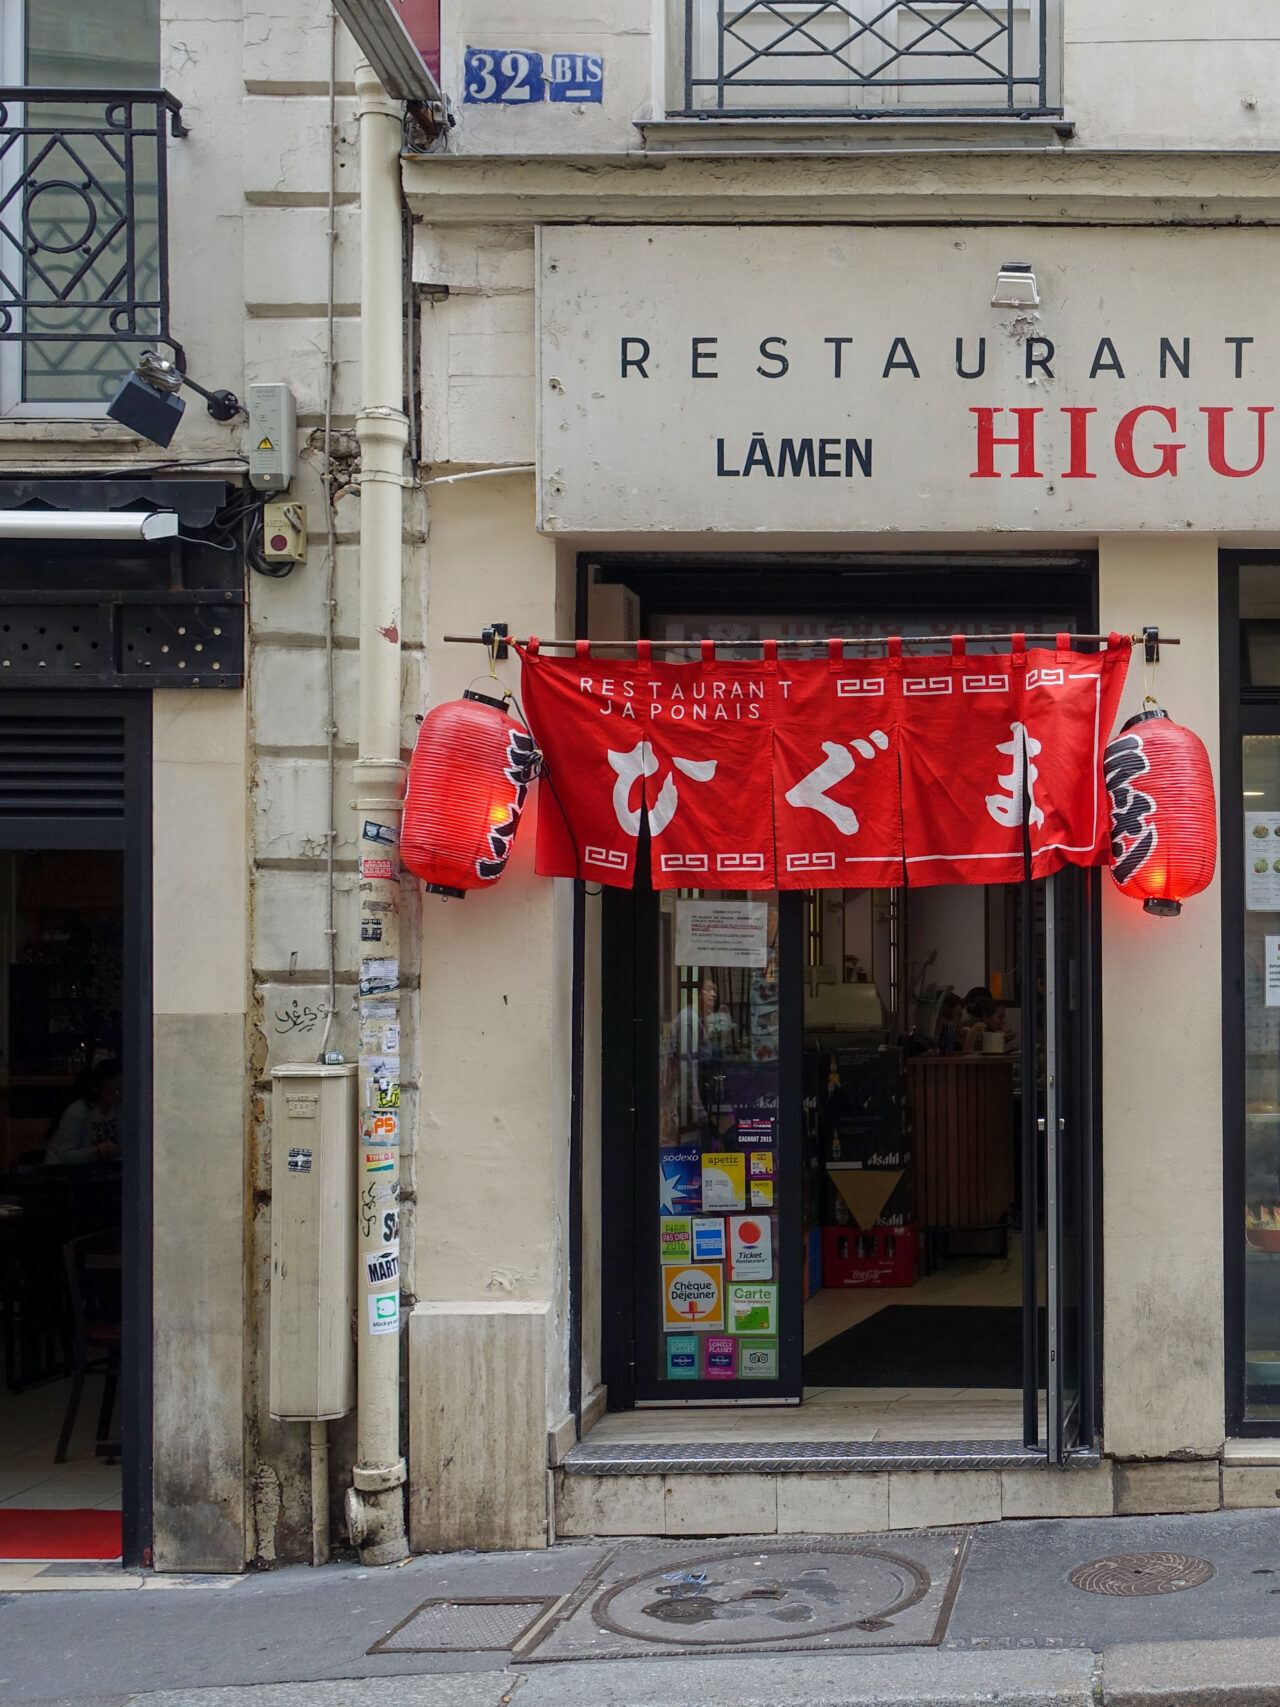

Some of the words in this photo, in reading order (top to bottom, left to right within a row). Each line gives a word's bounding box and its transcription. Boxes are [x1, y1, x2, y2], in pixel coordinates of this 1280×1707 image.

[469, 53, 533, 100] 32
[554, 56, 602, 84] BIS
[620, 336, 1254, 379] RESTAURANT
[717, 431, 873, 478] LĀMEN
[580, 677, 792, 700] RESTAURANT
[600, 699, 760, 720] JAPONAIS
[760, 1135, 772, 1143] 2015
[662, 1152, 699, 1163] sodexo
[708, 1155, 739, 1165] apetiz
[867, 1152, 900, 1166] Asahi
[674, 1281, 712, 1293] Chèque
[734, 1288, 772, 1299] Carte
[671, 1290, 716, 1302] Déjeuner
